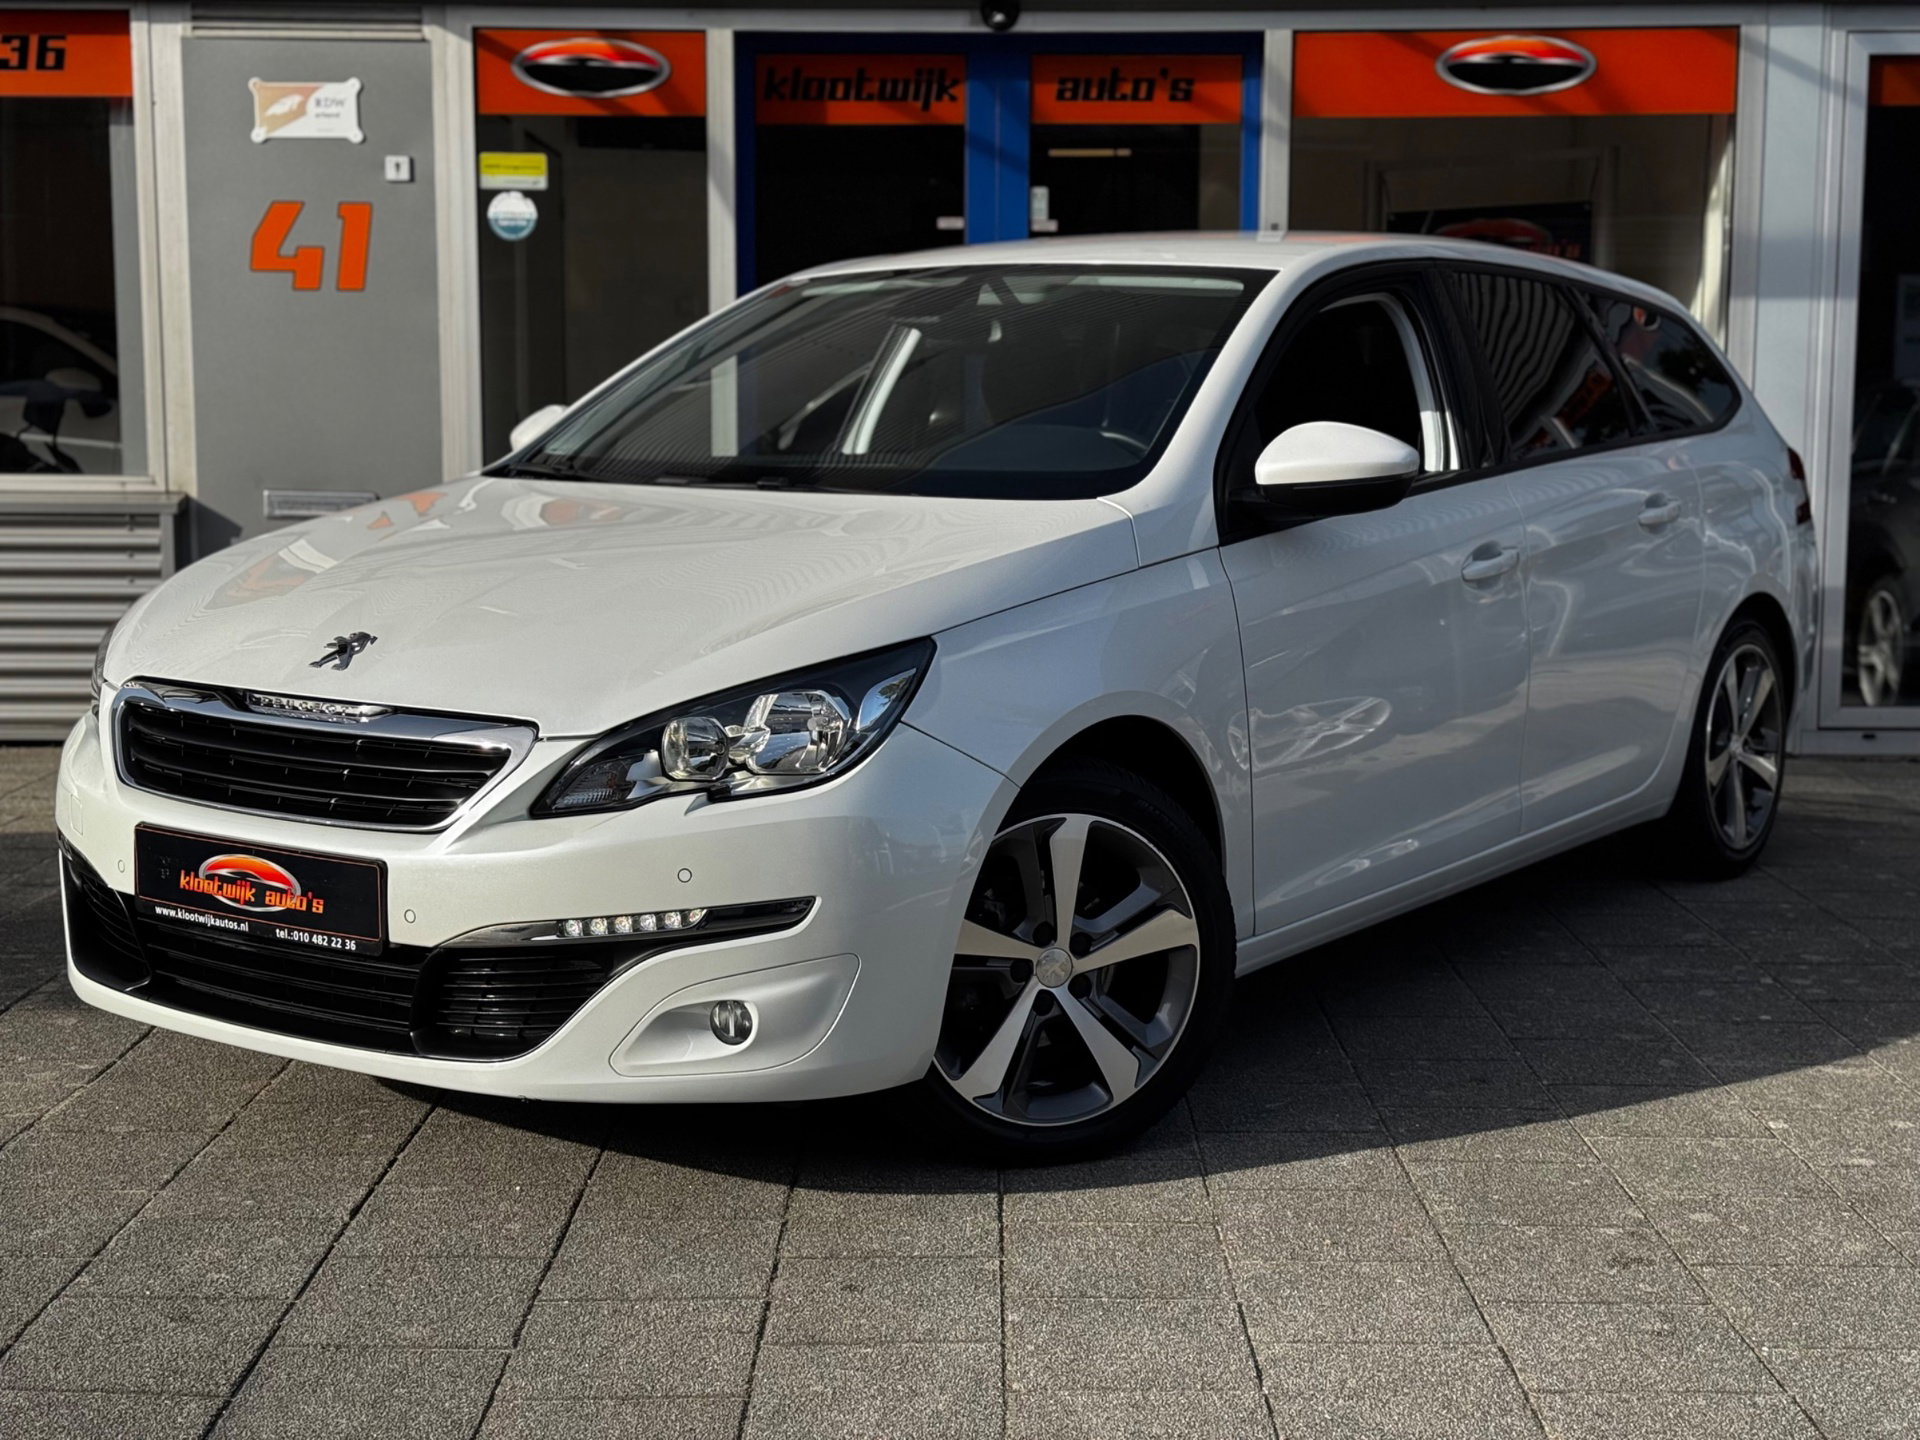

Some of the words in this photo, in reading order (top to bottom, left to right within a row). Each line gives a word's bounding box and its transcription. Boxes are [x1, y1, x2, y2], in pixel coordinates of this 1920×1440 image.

[763, 68, 960, 112] klootwijk
[1056, 67, 1195, 102] auto's
[250, 200, 372, 291] 41
[179, 869, 257, 905] klootwijk
[264, 888, 325, 914] auto's
[154, 905, 249, 932] www.klootwijkautos.nl
[275, 928, 310, 943] tel.:010
[311, 934, 329, 947] 482
[330, 936, 343, 949] 22
[344, 939, 357, 951] 36
